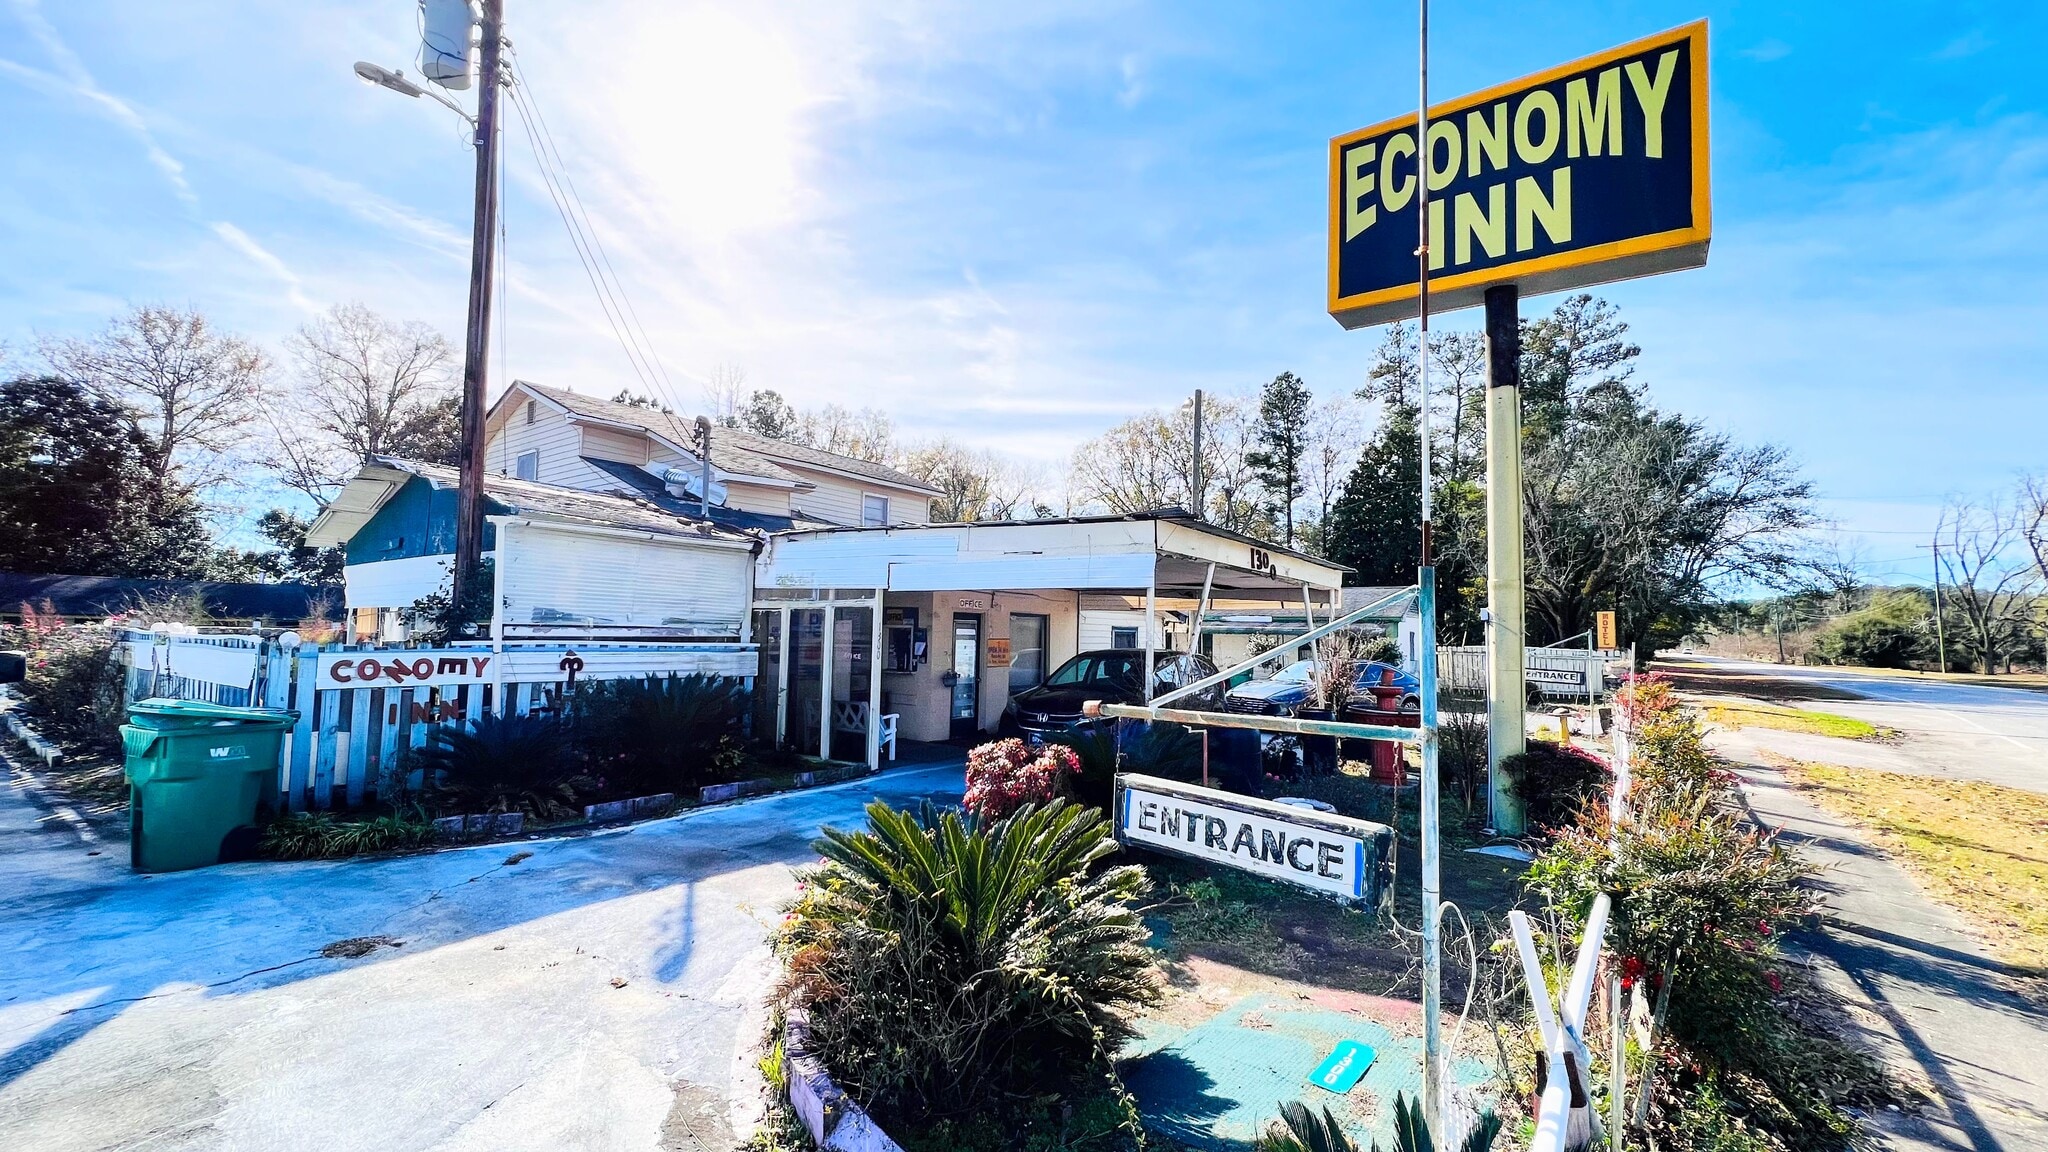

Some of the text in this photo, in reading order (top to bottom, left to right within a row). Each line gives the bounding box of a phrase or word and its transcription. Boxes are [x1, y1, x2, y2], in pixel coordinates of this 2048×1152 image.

[1346, 49, 1679, 243] ECONOMY
[1427, 166, 1572, 271] INN
[960, 600, 983, 608] OFFICE
[1602, 613, 1610, 645] MOTEL
[1526, 671, 1577, 681] ENTRANCE
[388, 700, 459, 725] INN
[1138, 800, 1345, 880] ENTRANCE
[1323, 1047, 1357, 1085] 1300
